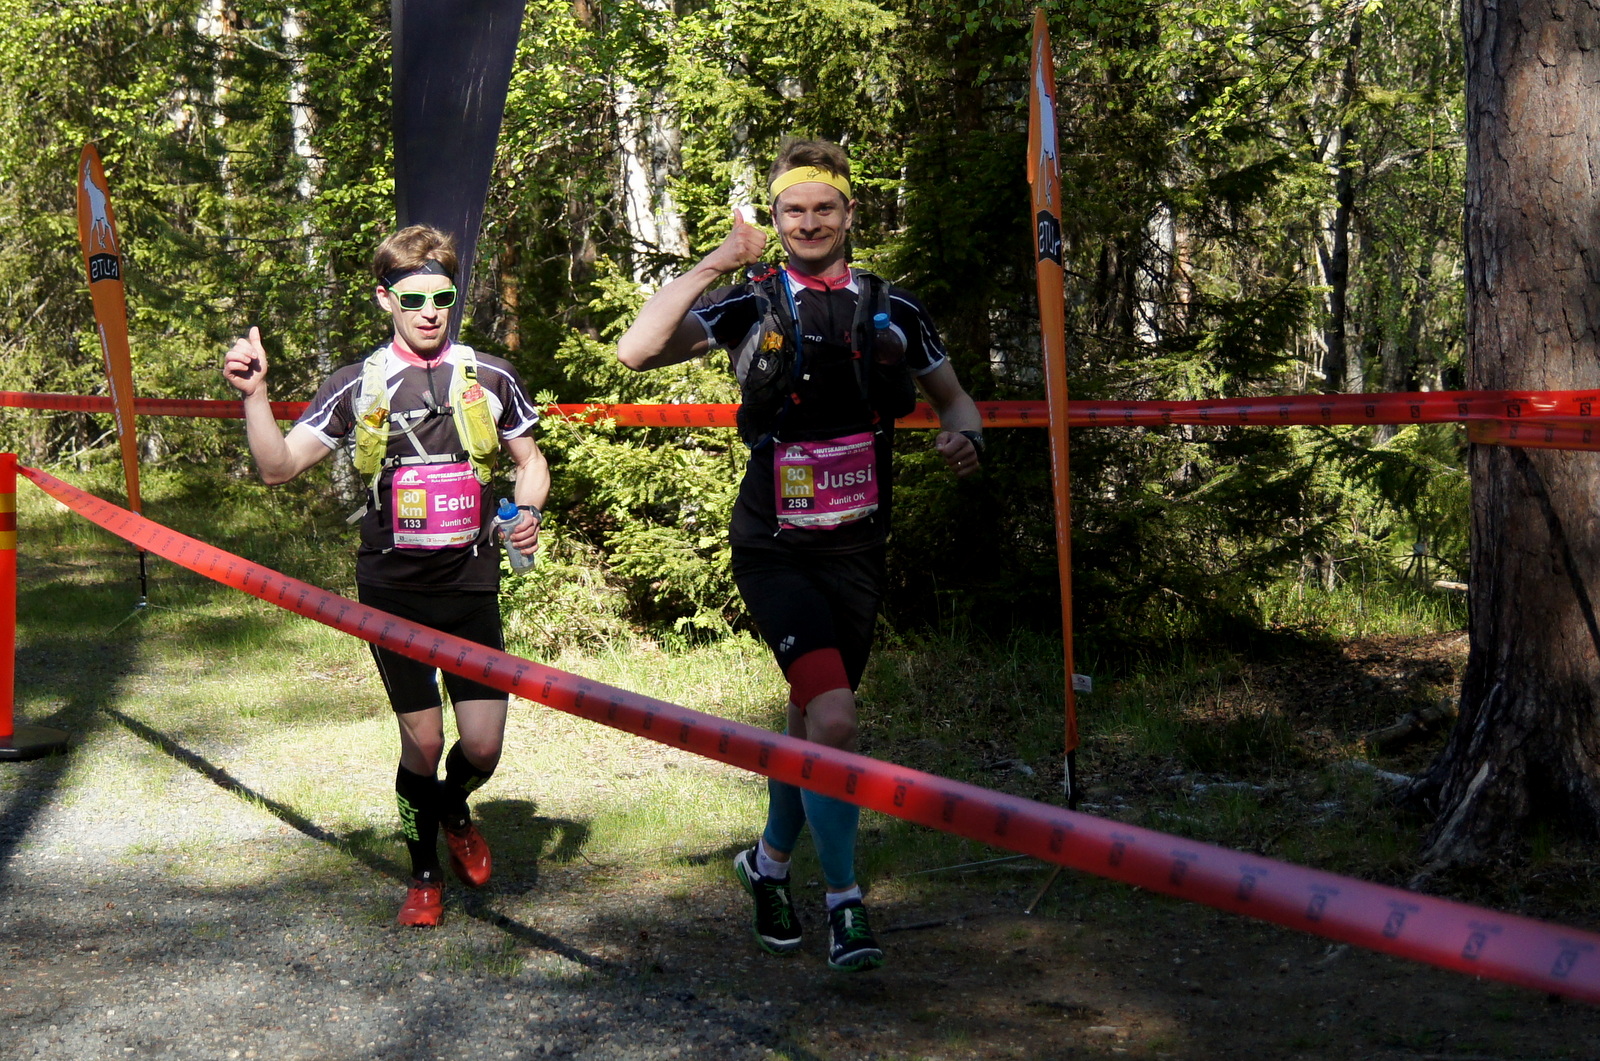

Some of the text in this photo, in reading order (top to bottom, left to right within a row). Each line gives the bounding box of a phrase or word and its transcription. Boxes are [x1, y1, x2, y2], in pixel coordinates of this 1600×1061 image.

[787, 468, 806, 481] 80
[816, 464, 872, 490] Jussi
[785, 483, 810, 496] km
[403, 491, 420, 503] 80
[434, 494, 475, 512] Eetu
[829, 496, 852, 506] Juntit
[853, 492, 866, 502] OK
[401, 504, 423, 517] km
[788, 499, 808, 509] 258
[403, 519, 421, 528] 133
[440, 516, 472, 527] Juntit OK
